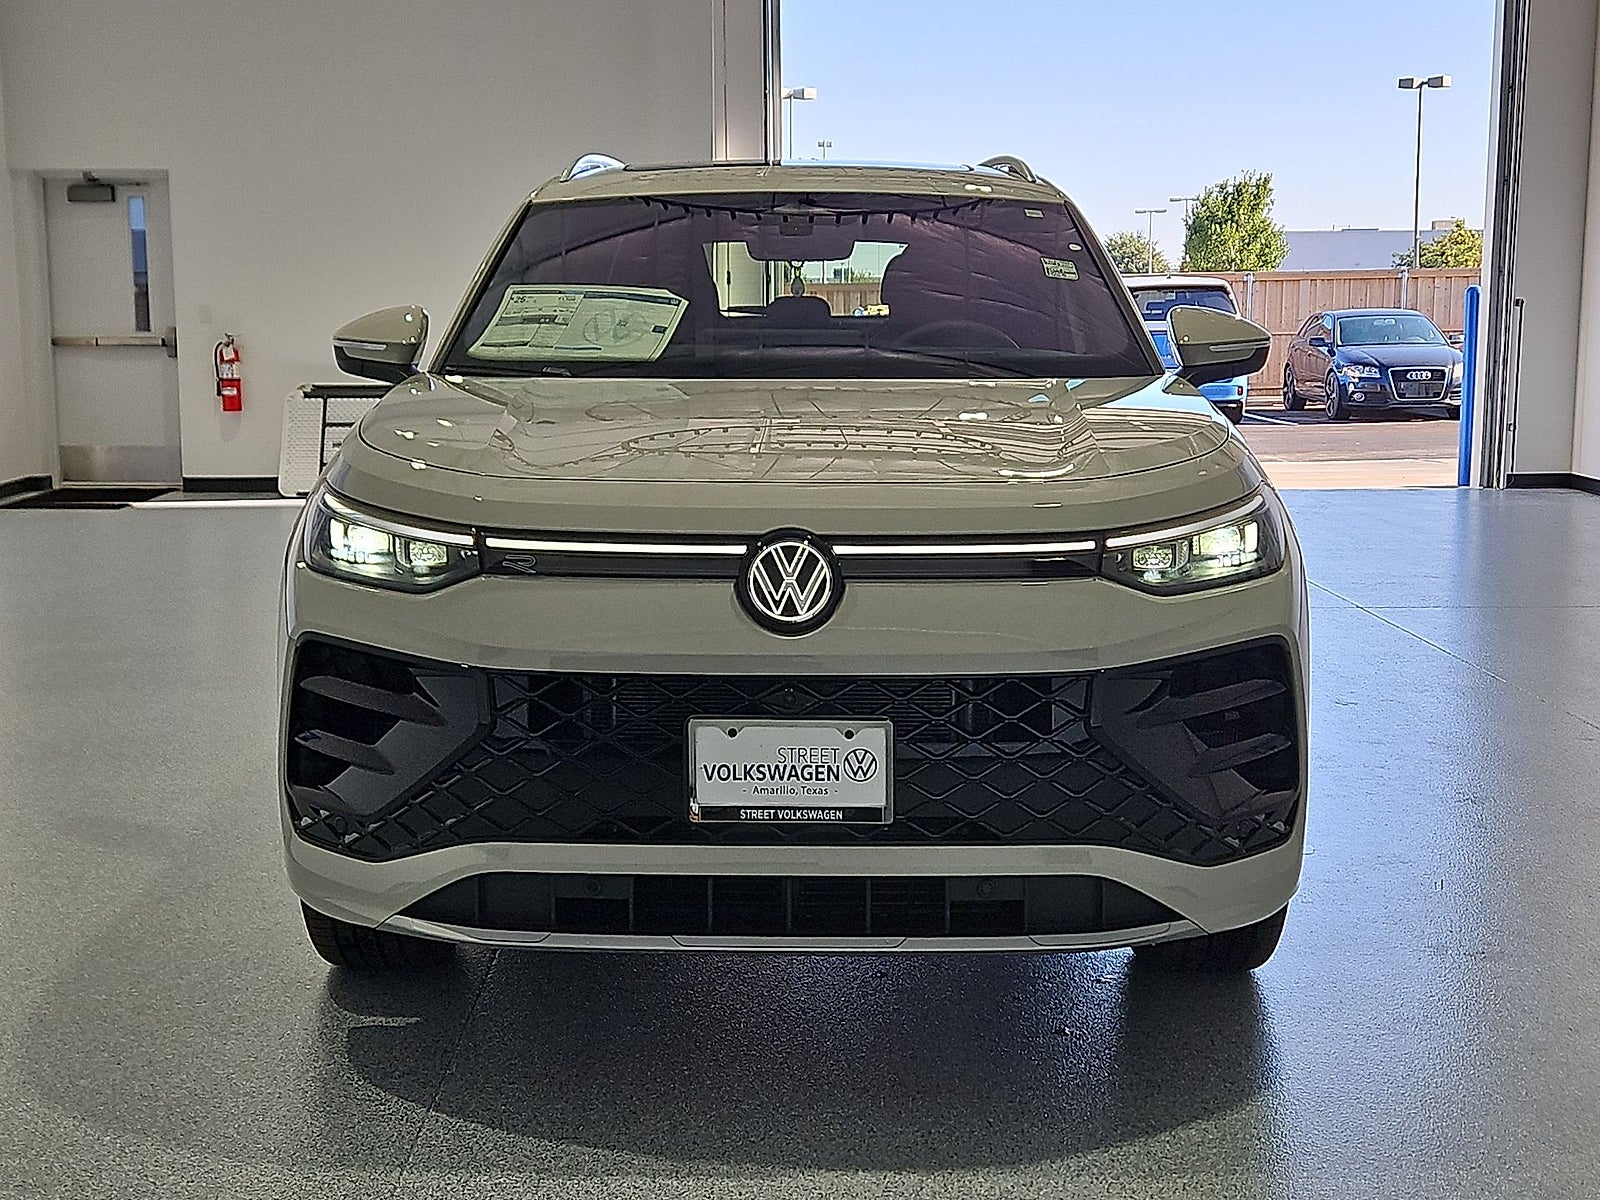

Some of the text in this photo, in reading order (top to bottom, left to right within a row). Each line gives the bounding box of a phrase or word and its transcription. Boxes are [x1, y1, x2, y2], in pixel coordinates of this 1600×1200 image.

[777, 747, 840, 764] STREET
[703, 763, 840, 782] VOLKSWAGEN
[752, 785, 829, 796] Amarillo, Texas
[740, 809, 843, 821] STREET VOLKSWAGEN
